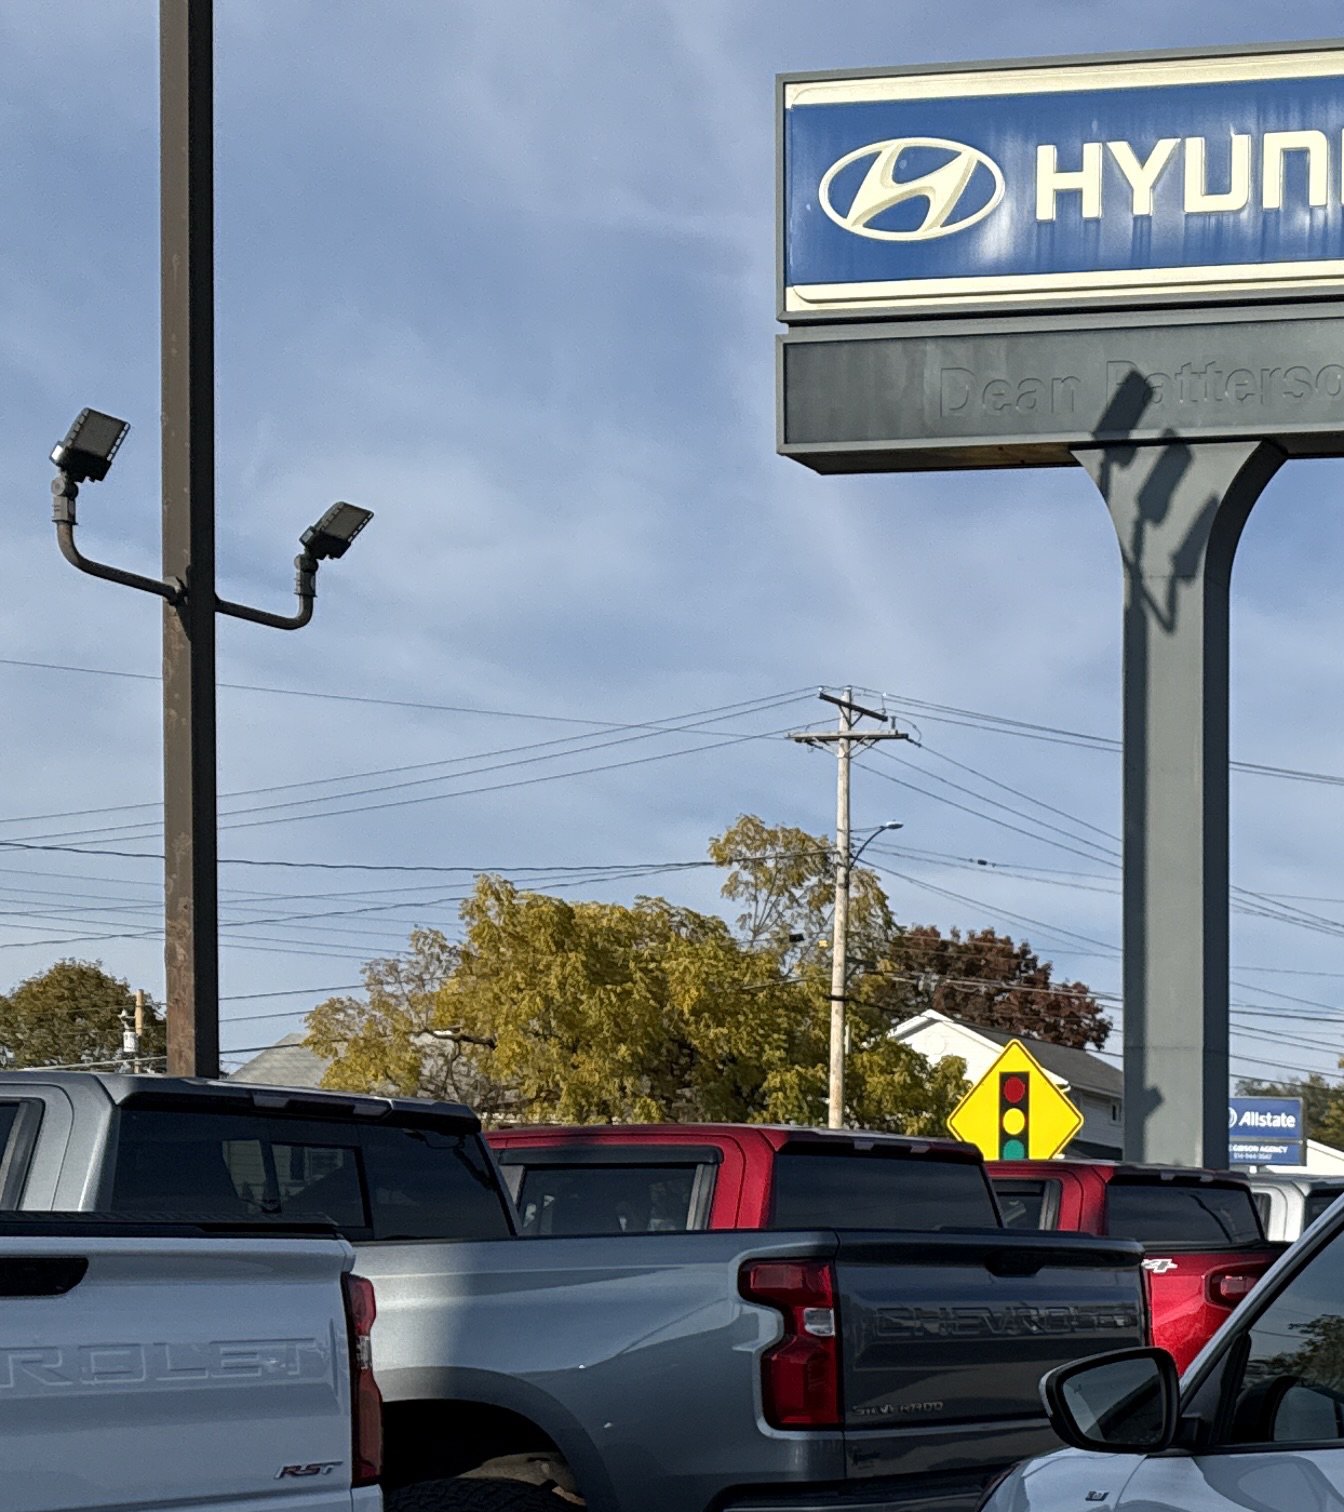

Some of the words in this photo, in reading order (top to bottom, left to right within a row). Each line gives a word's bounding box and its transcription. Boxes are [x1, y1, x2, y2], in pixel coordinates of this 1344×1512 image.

[939, 366, 1082, 417] Dean
[1238, 1111, 1296, 1128] Allstate
[274, 1460, 344, 1480] RST
